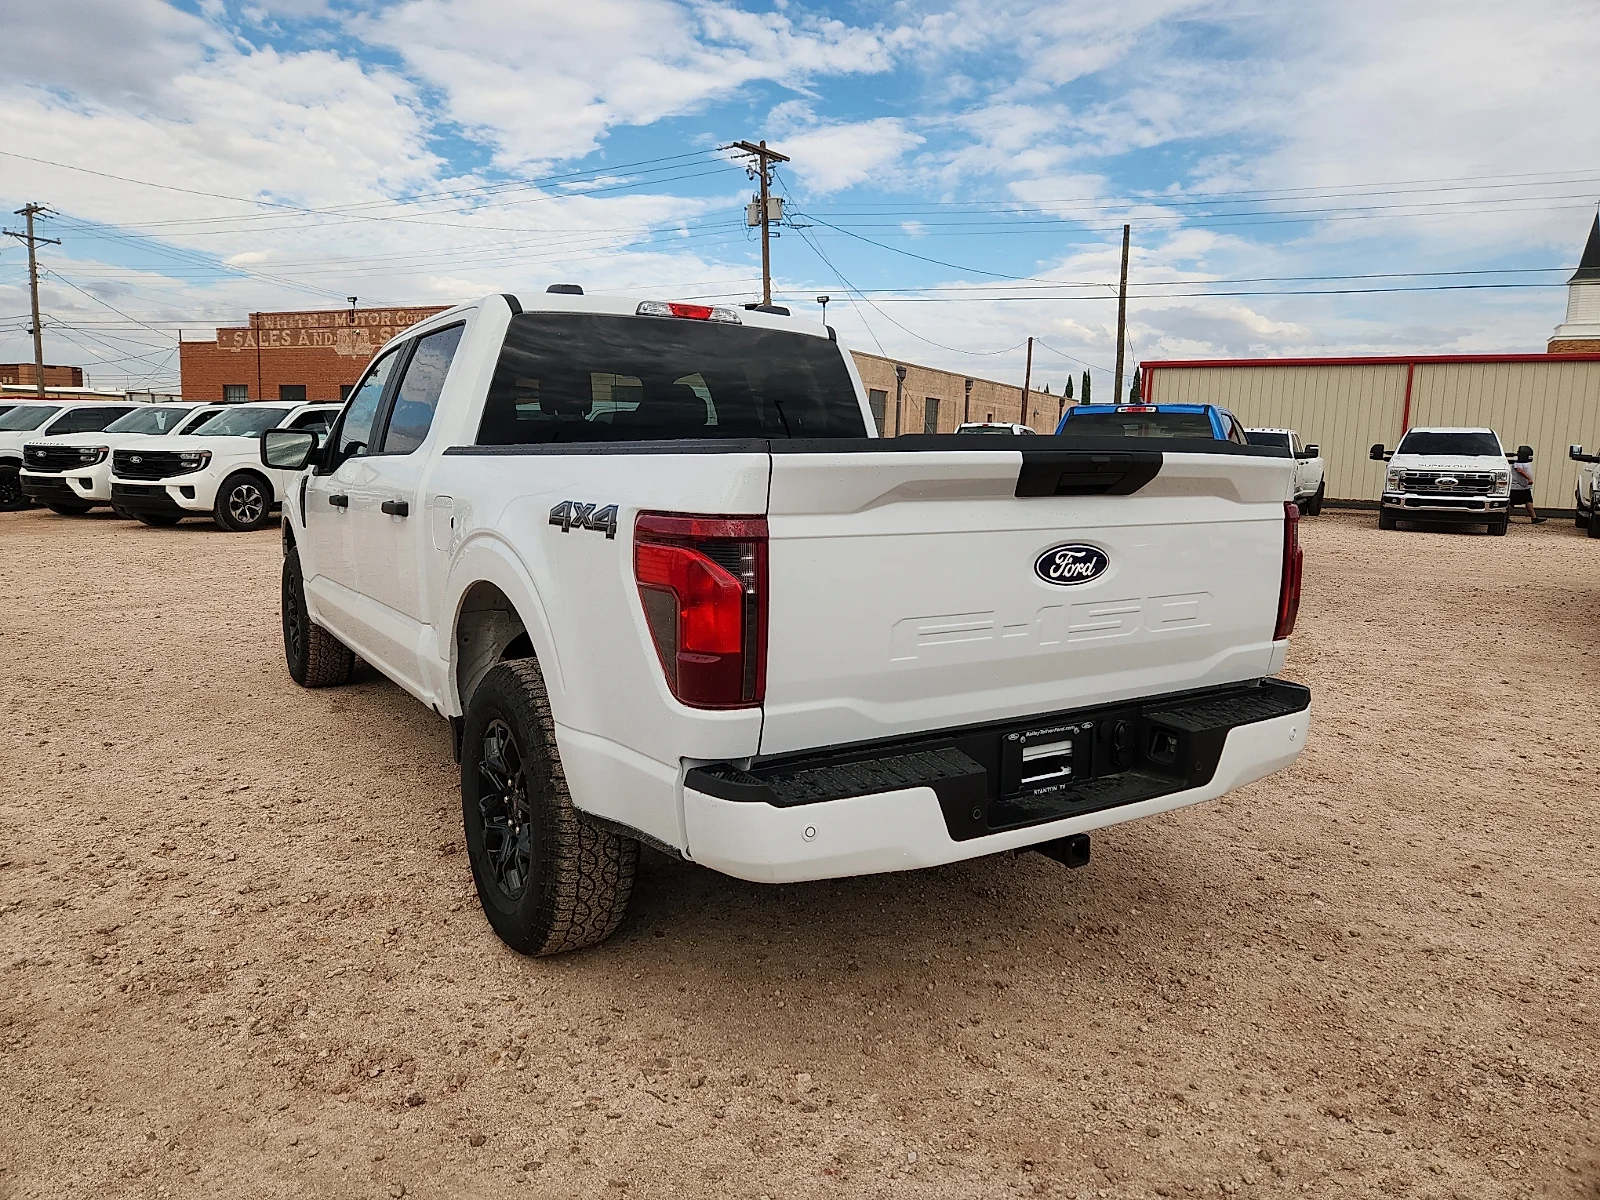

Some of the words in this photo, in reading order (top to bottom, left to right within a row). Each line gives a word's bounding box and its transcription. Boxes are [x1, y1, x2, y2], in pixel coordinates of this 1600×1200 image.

[334, 311, 391, 327] MOTOR
[232, 329, 291, 347] SALES
[298, 329, 334, 346] AND
[1049, 550, 1096, 578] Ford
[890, 591, 1214, 662] F-150
